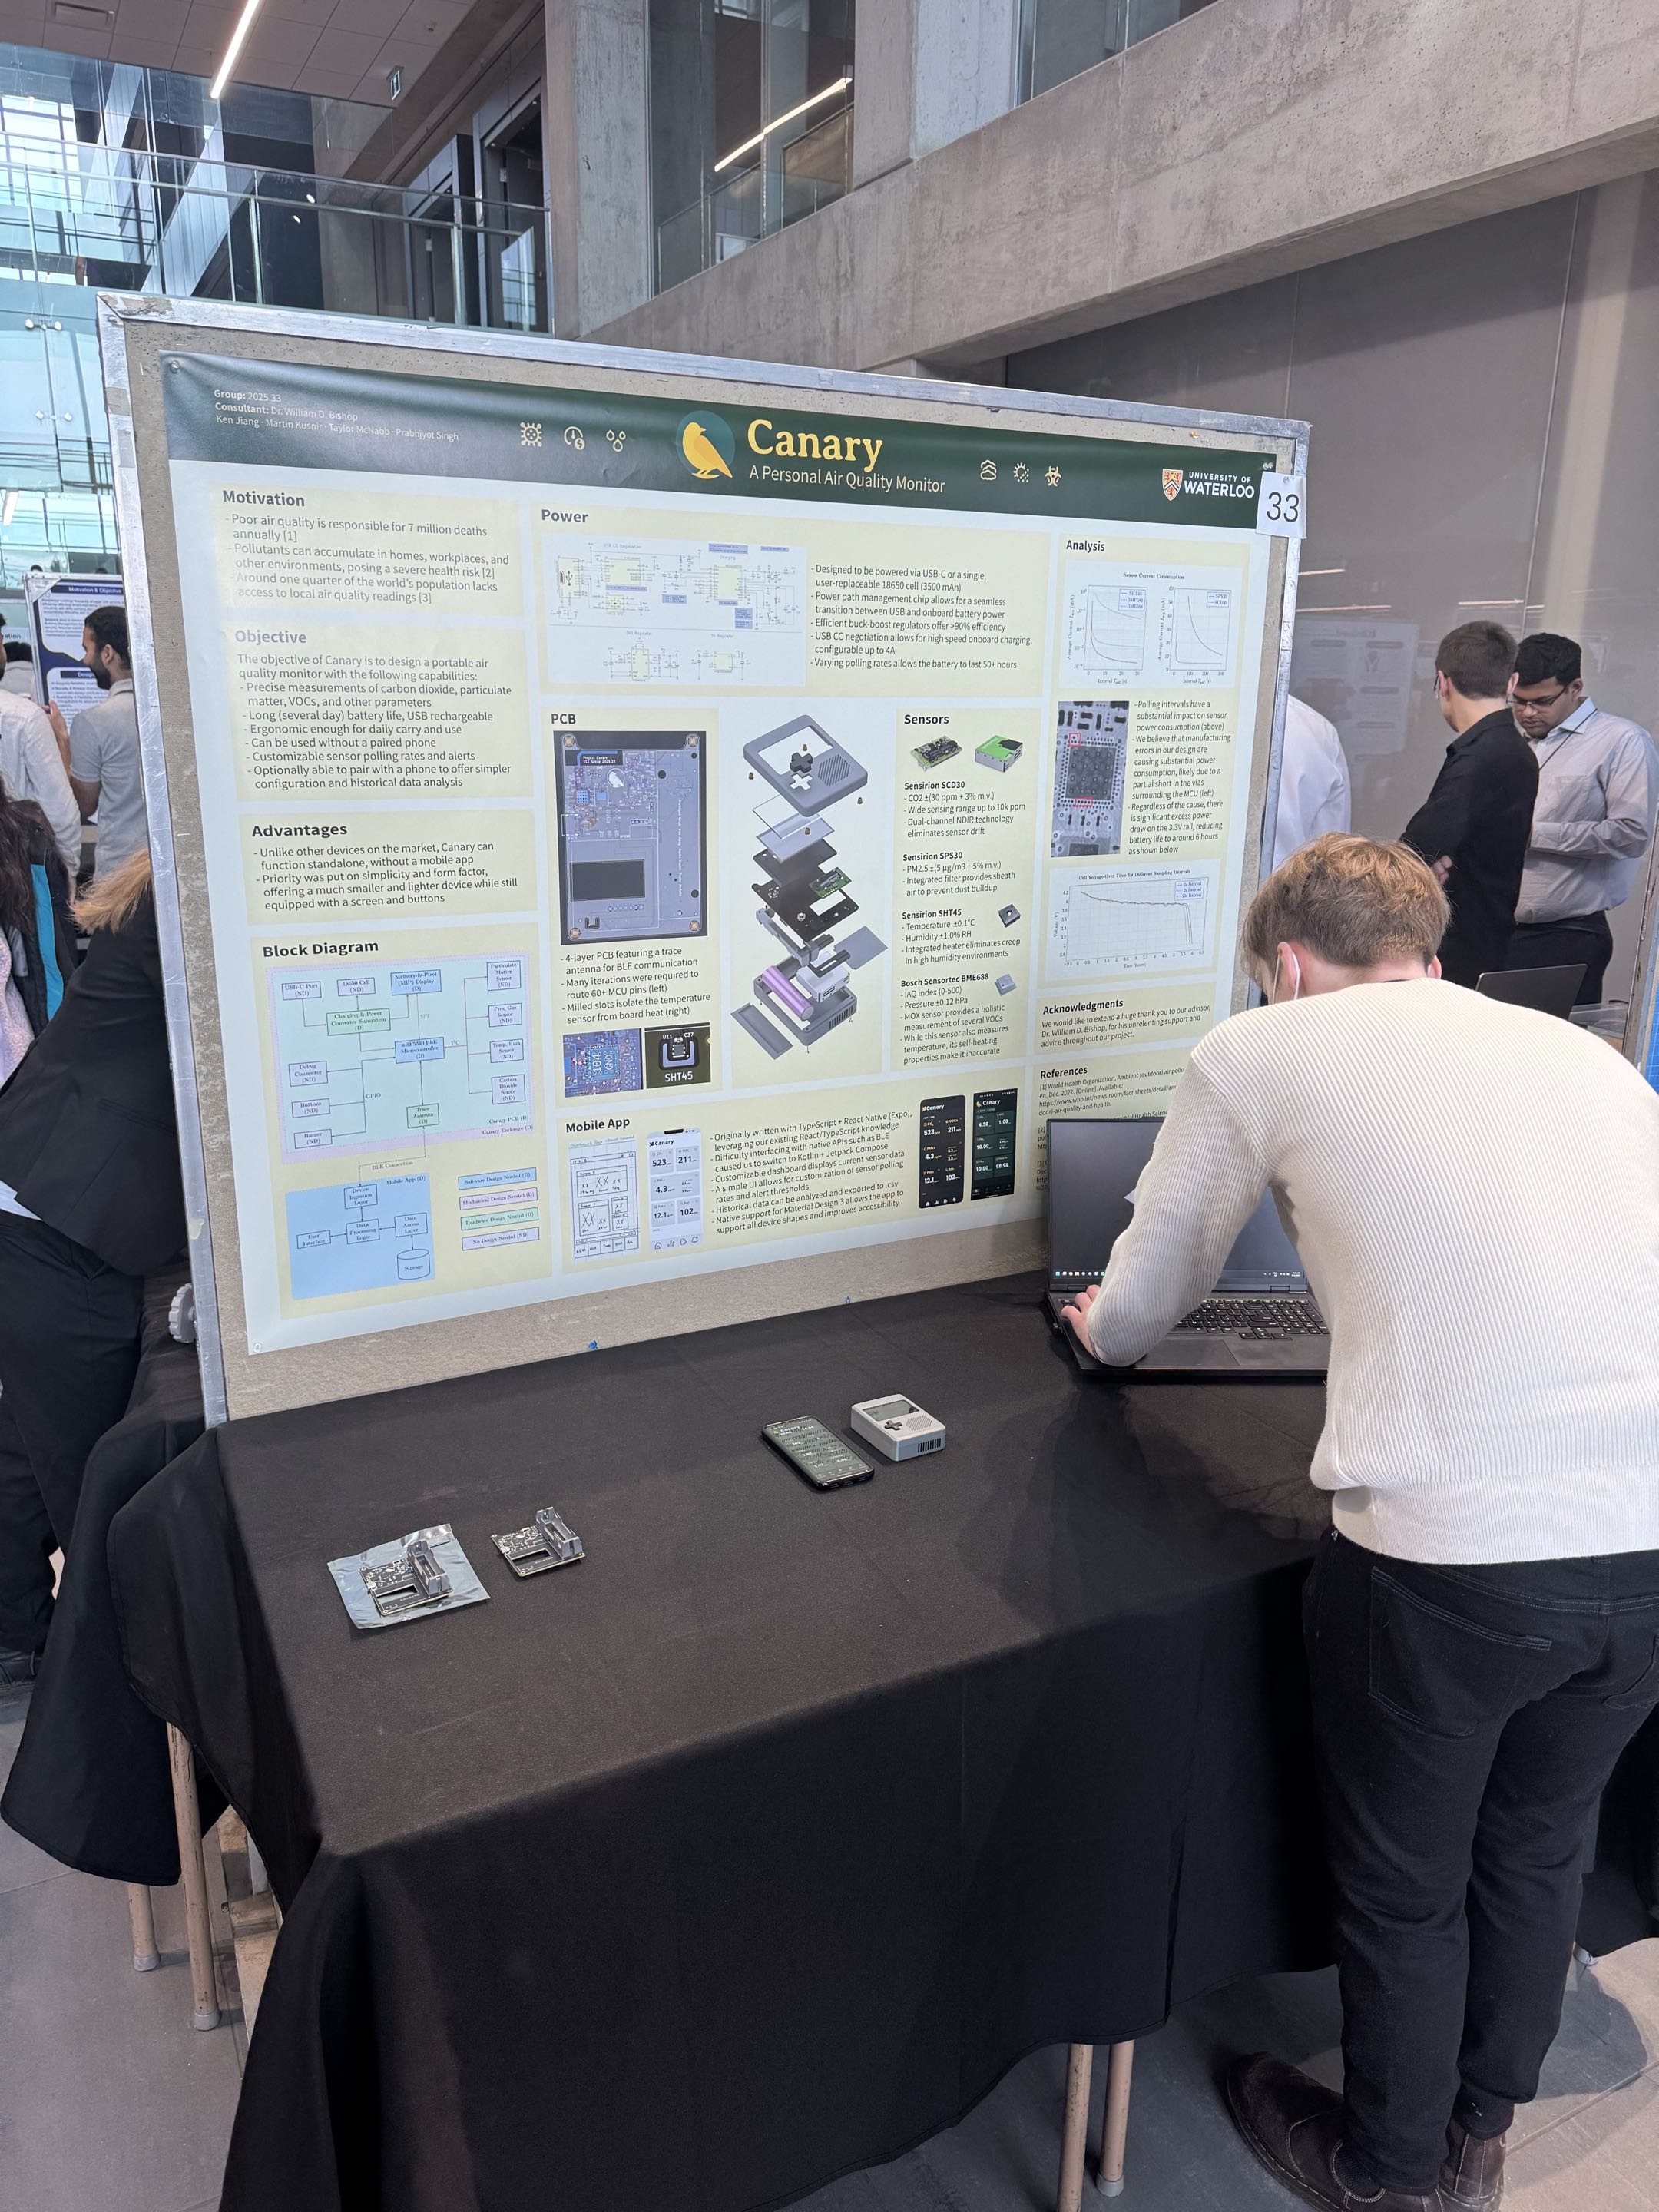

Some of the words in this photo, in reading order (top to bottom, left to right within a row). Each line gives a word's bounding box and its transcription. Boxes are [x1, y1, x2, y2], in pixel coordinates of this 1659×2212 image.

[214, 389, 245, 400] Group:
[247, 392, 281, 402] 2025.33
[215, 402, 269, 413] Consultant:
[284, 409, 316, 419] William
[329, 411, 357, 422] Bishop
[216, 414, 233, 423] Ken
[235, 414, 260, 429] Jiang
[265, 418, 293, 430] Martin
[295, 421, 323, 431] Kusnir
[328, 423, 354, 433] Taylor
[356, 426, 389, 435] McNabb
[396, 428, 434, 439] Prabhjyot
[436, 431, 458, 442] Singh
[747, 419, 882, 472] Canary
[749, 465, 758, 478] A
[763, 465, 820, 483] Personal
[824, 470, 843, 485] Air
[846, 472, 892, 492] Quality
[896, 475, 945, 492] Monitor
[1189, 472, 1237, 482] UNIVERSITY
[1184, 480, 1254, 498] WATERLOO
[223, 490, 304, 506] Motivation
[1267, 492, 1299, 522] 33
[541, 509, 588, 522] Power
[232, 514, 257, 524] Poor
[260, 515, 274, 525] air
[277, 516, 314, 529] quality
[317, 518, 326, 528] is
[329, 521, 389, 531] responsible
[391, 521, 406, 531] for
[408, 523, 413, 531] 7
[416, 523, 451, 534] million
[454, 525, 487, 535] deaths
[1066, 540, 1104, 552] Analysis
[816, 564, 852, 575] Designed
[863, 566, 873, 575] be
[875, 568, 908, 577] powered
[910, 568, 920, 577] via
[922, 569, 945, 578] USB-C
[963, 571, 985, 581] single,
[235, 630, 306, 644] Objective
[237, 654, 257, 663] The
[260, 654, 310, 666] objective
[312, 654, 322, 664] of
[325, 655, 361, 667] Canary
[364, 656, 373, 665] is
[375, 657, 385, 665] to
[388, 656, 420, 668] design
[432, 657, 473, 668] portable
[475, 658, 488, 667] air
[1137, 700, 1160, 710] Polling
[250, 710, 276, 722] Long
[279, 710, 319, 721] (several
[322, 710, 343, 722] day)
[347, 710, 383, 722] battery
[386, 710, 404, 721] life,
[407, 711, 427, 720] USB
[430, 711, 492, 723] rechargeable
[551, 714, 575, 724] PCB
[904, 714, 949, 724] Sensors
[905, 781, 939, 790] Sensirion
[252, 825, 346, 838] Advantages
[260, 847, 293, 856] Unlike
[296, 846, 324, 856] other
[326, 846, 364, 855] devices
[382, 844, 399, 853] the
[402, 843, 439, 853] market,
[441, 843, 475, 853] Canary
[902, 853, 937, 861] Sensirion
[902, 910, 936, 919] Sensirion
[906, 922, 950, 931] Temperature
[263, 944, 308, 957] Block
[313, 942, 378, 955] Diagram
[565, 953, 594, 962] 4-layer
[597, 951, 613, 959] PCB
[616, 949, 653, 958] featuring
[924, 976, 959, 985] Sensortec
[961, 973, 988, 982] BME688
[1043, 999, 1123, 1014] Acknowledgments
[1053, 1018, 1072, 1026] would
[1094, 1013, 1114, 1022] extend
[1137, 1009, 1155, 1018] thank
[664, 1071, 692, 1081] SHT45
[1041, 1067, 1087, 1078] References
[1075, 1085, 1097, 1094] [Online].
[566, 1120, 604, 1132] Mobile
[608, 1118, 629, 1129] App
[714, 1130, 750, 1141] Originally
[780, 1124, 796, 1132] with
[798, 1120, 836, 1131] TypeScript
[844, 1116, 863, 1128] React
[889, 1109, 912, 1120] (Expo),
[652, 1158, 666, 1167] 523
